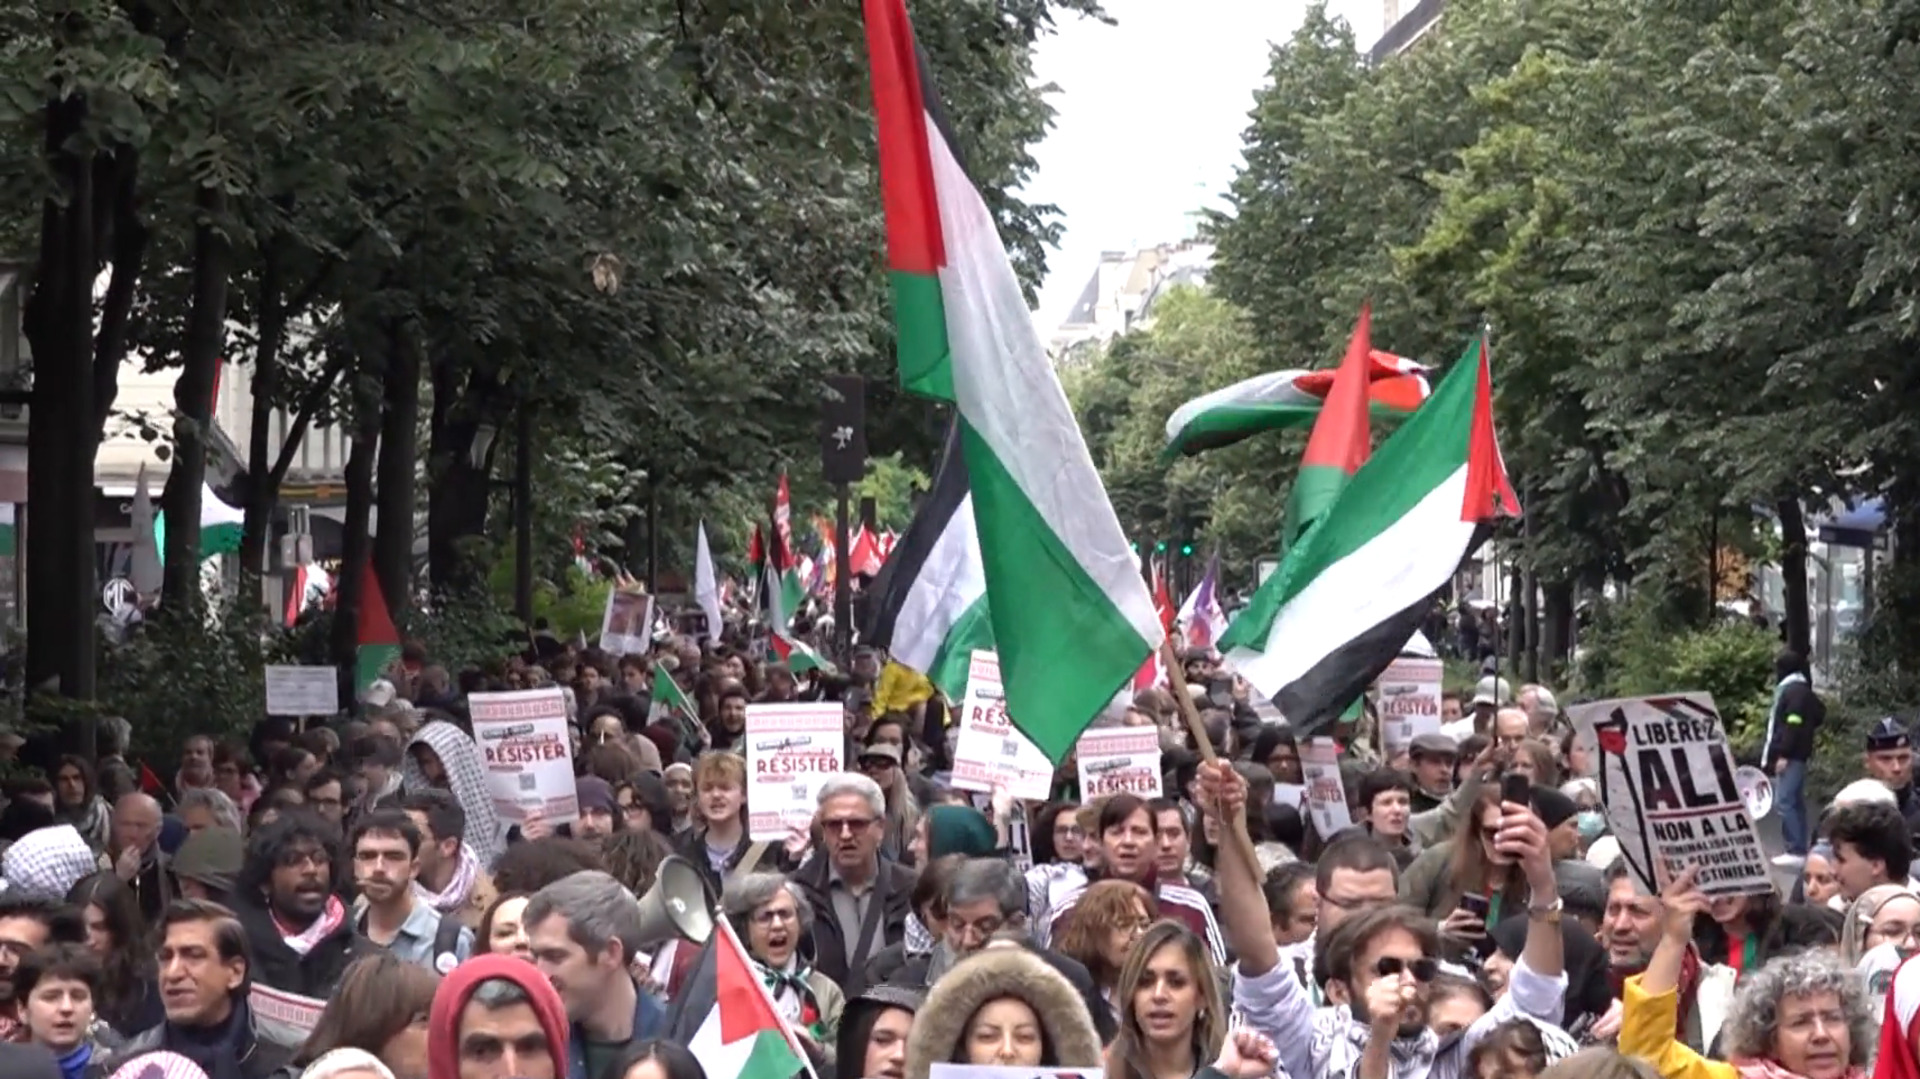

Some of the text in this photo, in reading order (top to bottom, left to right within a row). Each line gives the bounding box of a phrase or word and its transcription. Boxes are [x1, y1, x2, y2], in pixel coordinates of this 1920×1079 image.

[1638, 744, 1740, 811] ALI
[1653, 820, 1694, 841] NON
[1721, 813, 1749, 833] LA
